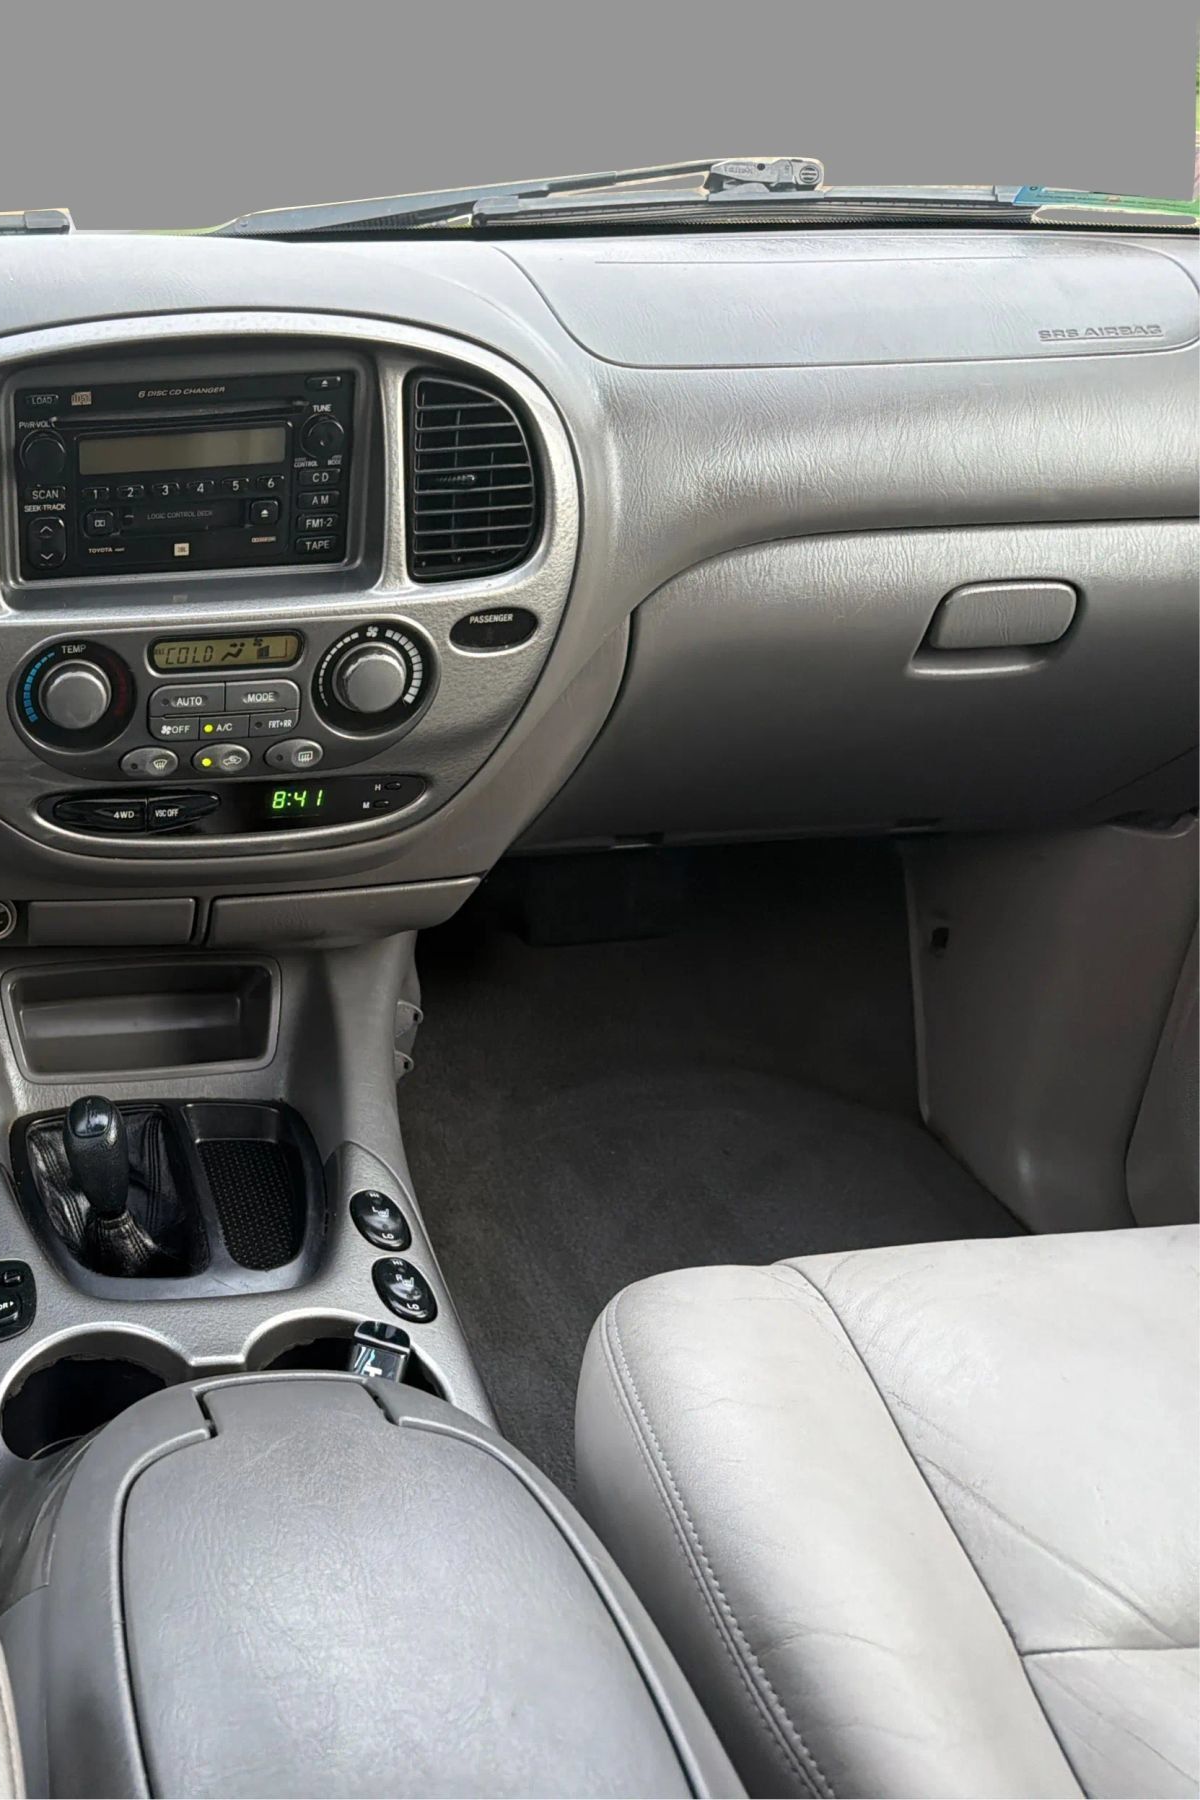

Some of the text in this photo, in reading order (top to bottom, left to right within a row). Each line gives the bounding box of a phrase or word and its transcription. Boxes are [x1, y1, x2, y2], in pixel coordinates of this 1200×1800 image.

[1038, 324, 1163, 339] SRS AIRBAG
[138, 386, 226, 399] 6 DISC CD CHANGER
[32, 396, 53, 405] LOAD
[312, 404, 332, 412] TUNE
[196, 483, 204, 493] 4
[232, 481, 239, 491] 5
[267, 478, 275, 489] 6
[32, 489, 59, 500] SCAN
[93, 489, 98, 499] 1
[127, 487, 134, 498] 2
[162, 485, 169, 496] 3
[306, 540, 330, 551] TAPE
[469, 613, 513, 624] PASSENGER
[61, 645, 86, 654] TEMP
[165, 645, 214, 665] COLD
[176, 696, 203, 706] AUTO
[247, 692, 274, 702] MODE
[172, 725, 191, 734] OFF
[216, 723, 233, 732] A/C
[374, 784, 381, 792] H
[272, 789, 323, 809] 8:41
[363, 801, 370, 809] M
[113, 810, 135, 820] 4WD
[155, 808, 179, 819] VSC OFF
[381, 1232, 395, 1240] LO
[406, 1303, 420, 1311] LO
